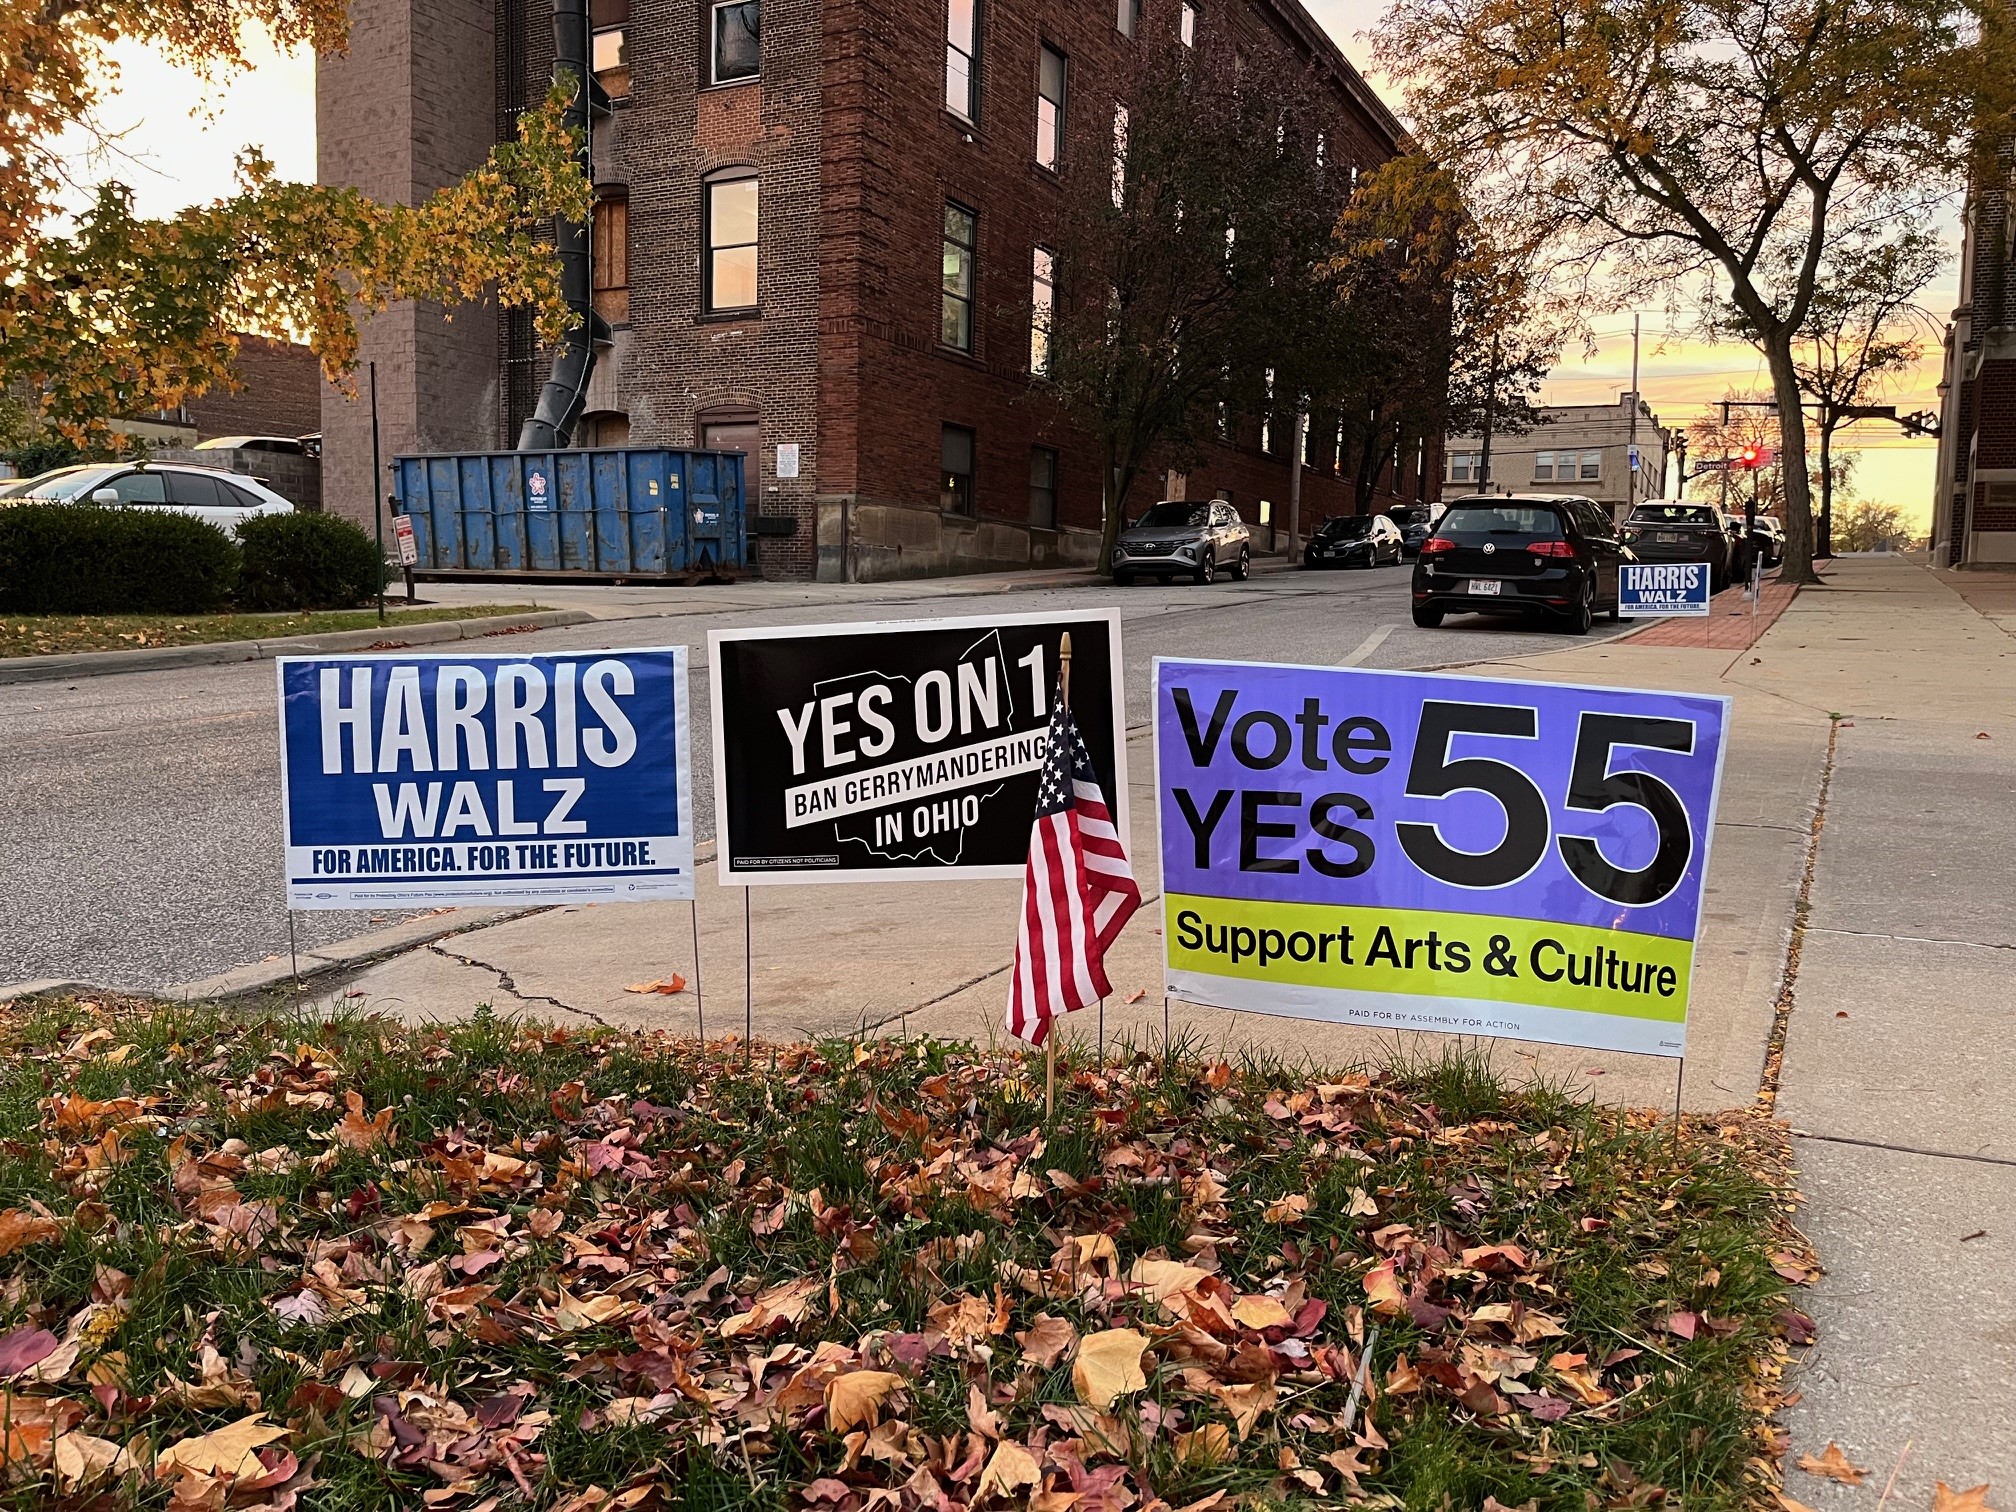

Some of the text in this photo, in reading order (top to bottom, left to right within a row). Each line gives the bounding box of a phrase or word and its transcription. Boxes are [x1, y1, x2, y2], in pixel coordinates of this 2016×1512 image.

[1628, 566, 1699, 590] HARRIS
[1639, 590, 1687, 603] WALZ
[319, 659, 637, 774] HARRIS
[777, 644, 1046, 776] YES ON 1
[1171, 687, 1392, 775] Vote
[372, 777, 588, 838] WALZ
[794, 735, 1046, 817] BAN GERRYMANDERING
[1395, 698, 1697, 908] 55
[313, 841, 656, 874] FOR AMERICA. FOR THE FUTURE.
[876, 795, 979, 847] IN OHIO
[1171, 788, 1375, 878] YES
[1177, 910, 1677, 998] Support Arts & Culture
[1349, 1009, 1521, 1031] PAID FOR BY ASSEMBLY FOR ACTION
